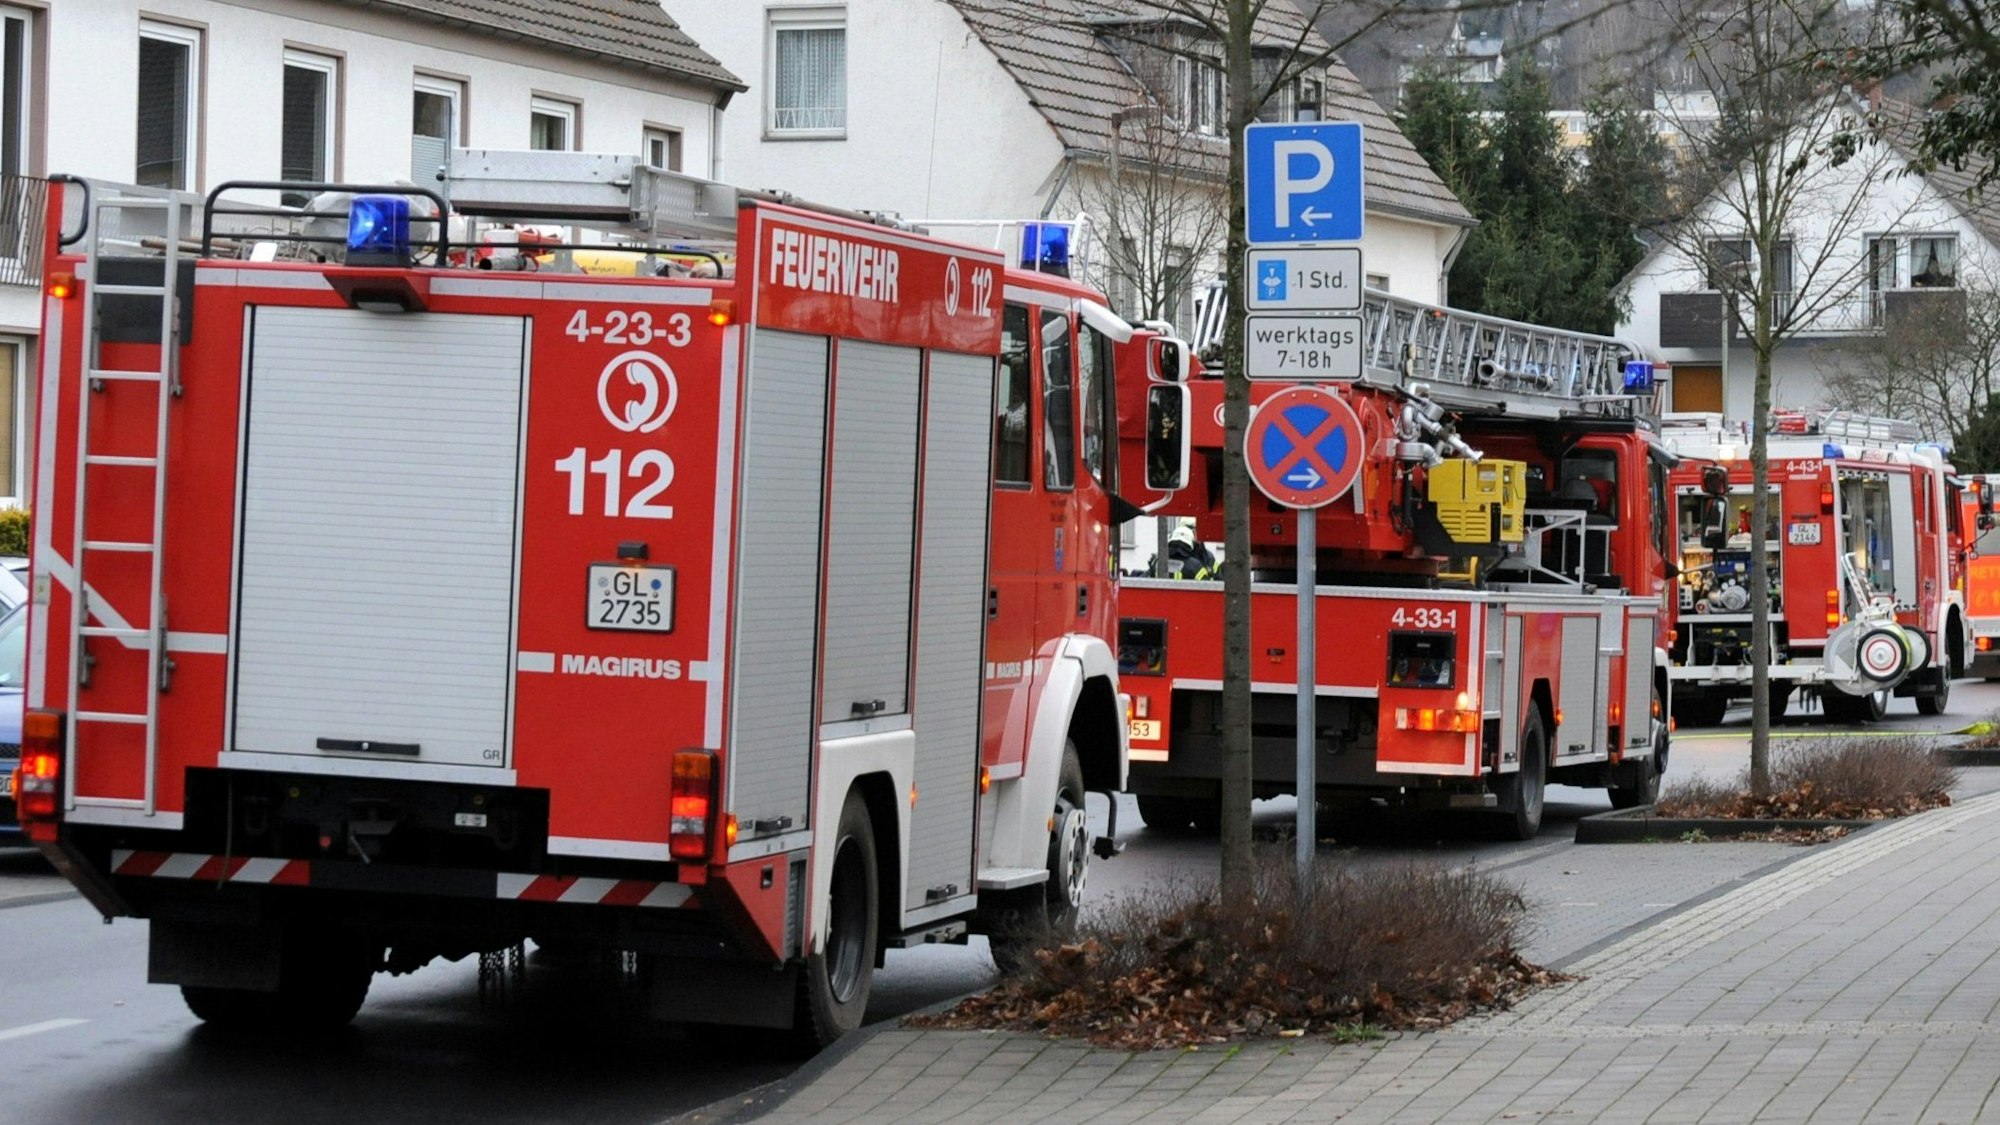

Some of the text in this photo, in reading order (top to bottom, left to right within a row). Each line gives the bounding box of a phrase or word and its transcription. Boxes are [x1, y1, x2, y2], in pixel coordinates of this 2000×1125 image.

[1274, 139, 1335, 228] P
[770, 227, 993, 318] FEUERWEHR 112
[1297, 271, 1303, 288] 1
[565, 309, 692, 347] 4-23-3
[1256, 326, 1354, 349] werktags
[554, 447, 675, 519] 112
[613, 571, 648, 597] GL
[600, 599, 661, 625] 2735
[1391, 607, 1457, 629] 4-33-1
[562, 654, 681, 680] MAGIRUS
[1129, 722, 1150, 737] 53
[483, 749, 500, 760] GR
